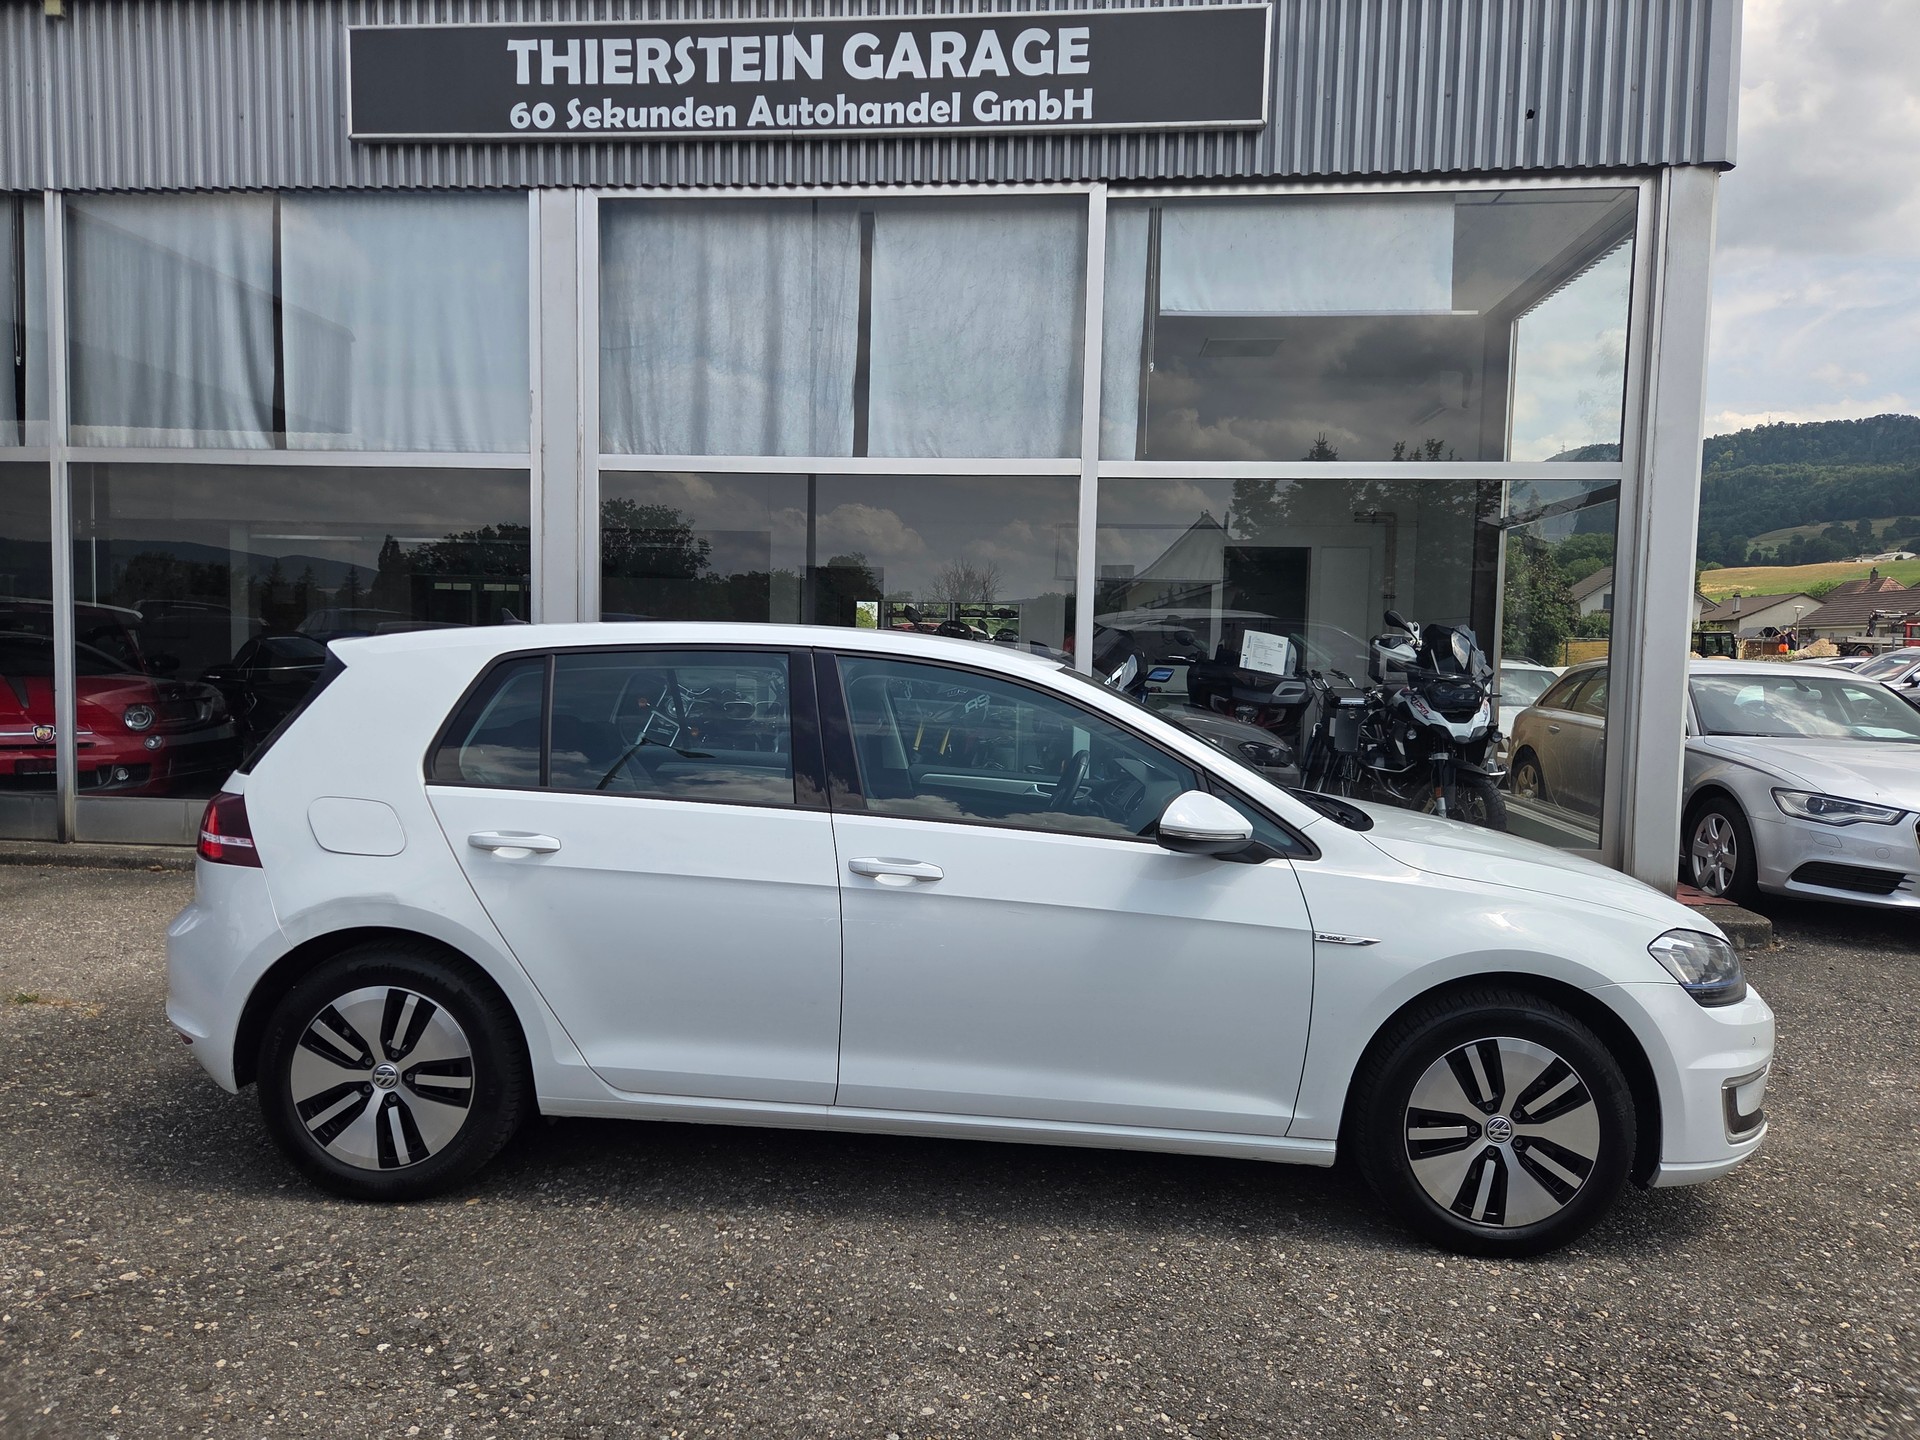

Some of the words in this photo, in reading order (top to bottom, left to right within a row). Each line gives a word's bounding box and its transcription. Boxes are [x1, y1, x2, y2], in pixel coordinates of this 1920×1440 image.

[506, 31, 824, 85] THIERSTEIN
[842, 26, 1091, 80] GARAGE
[509, 101, 556, 130] 60
[566, 96, 737, 130] Sekunden
[747, 91, 961, 127] Autohandel
[972, 87, 1093, 122] GmbH
